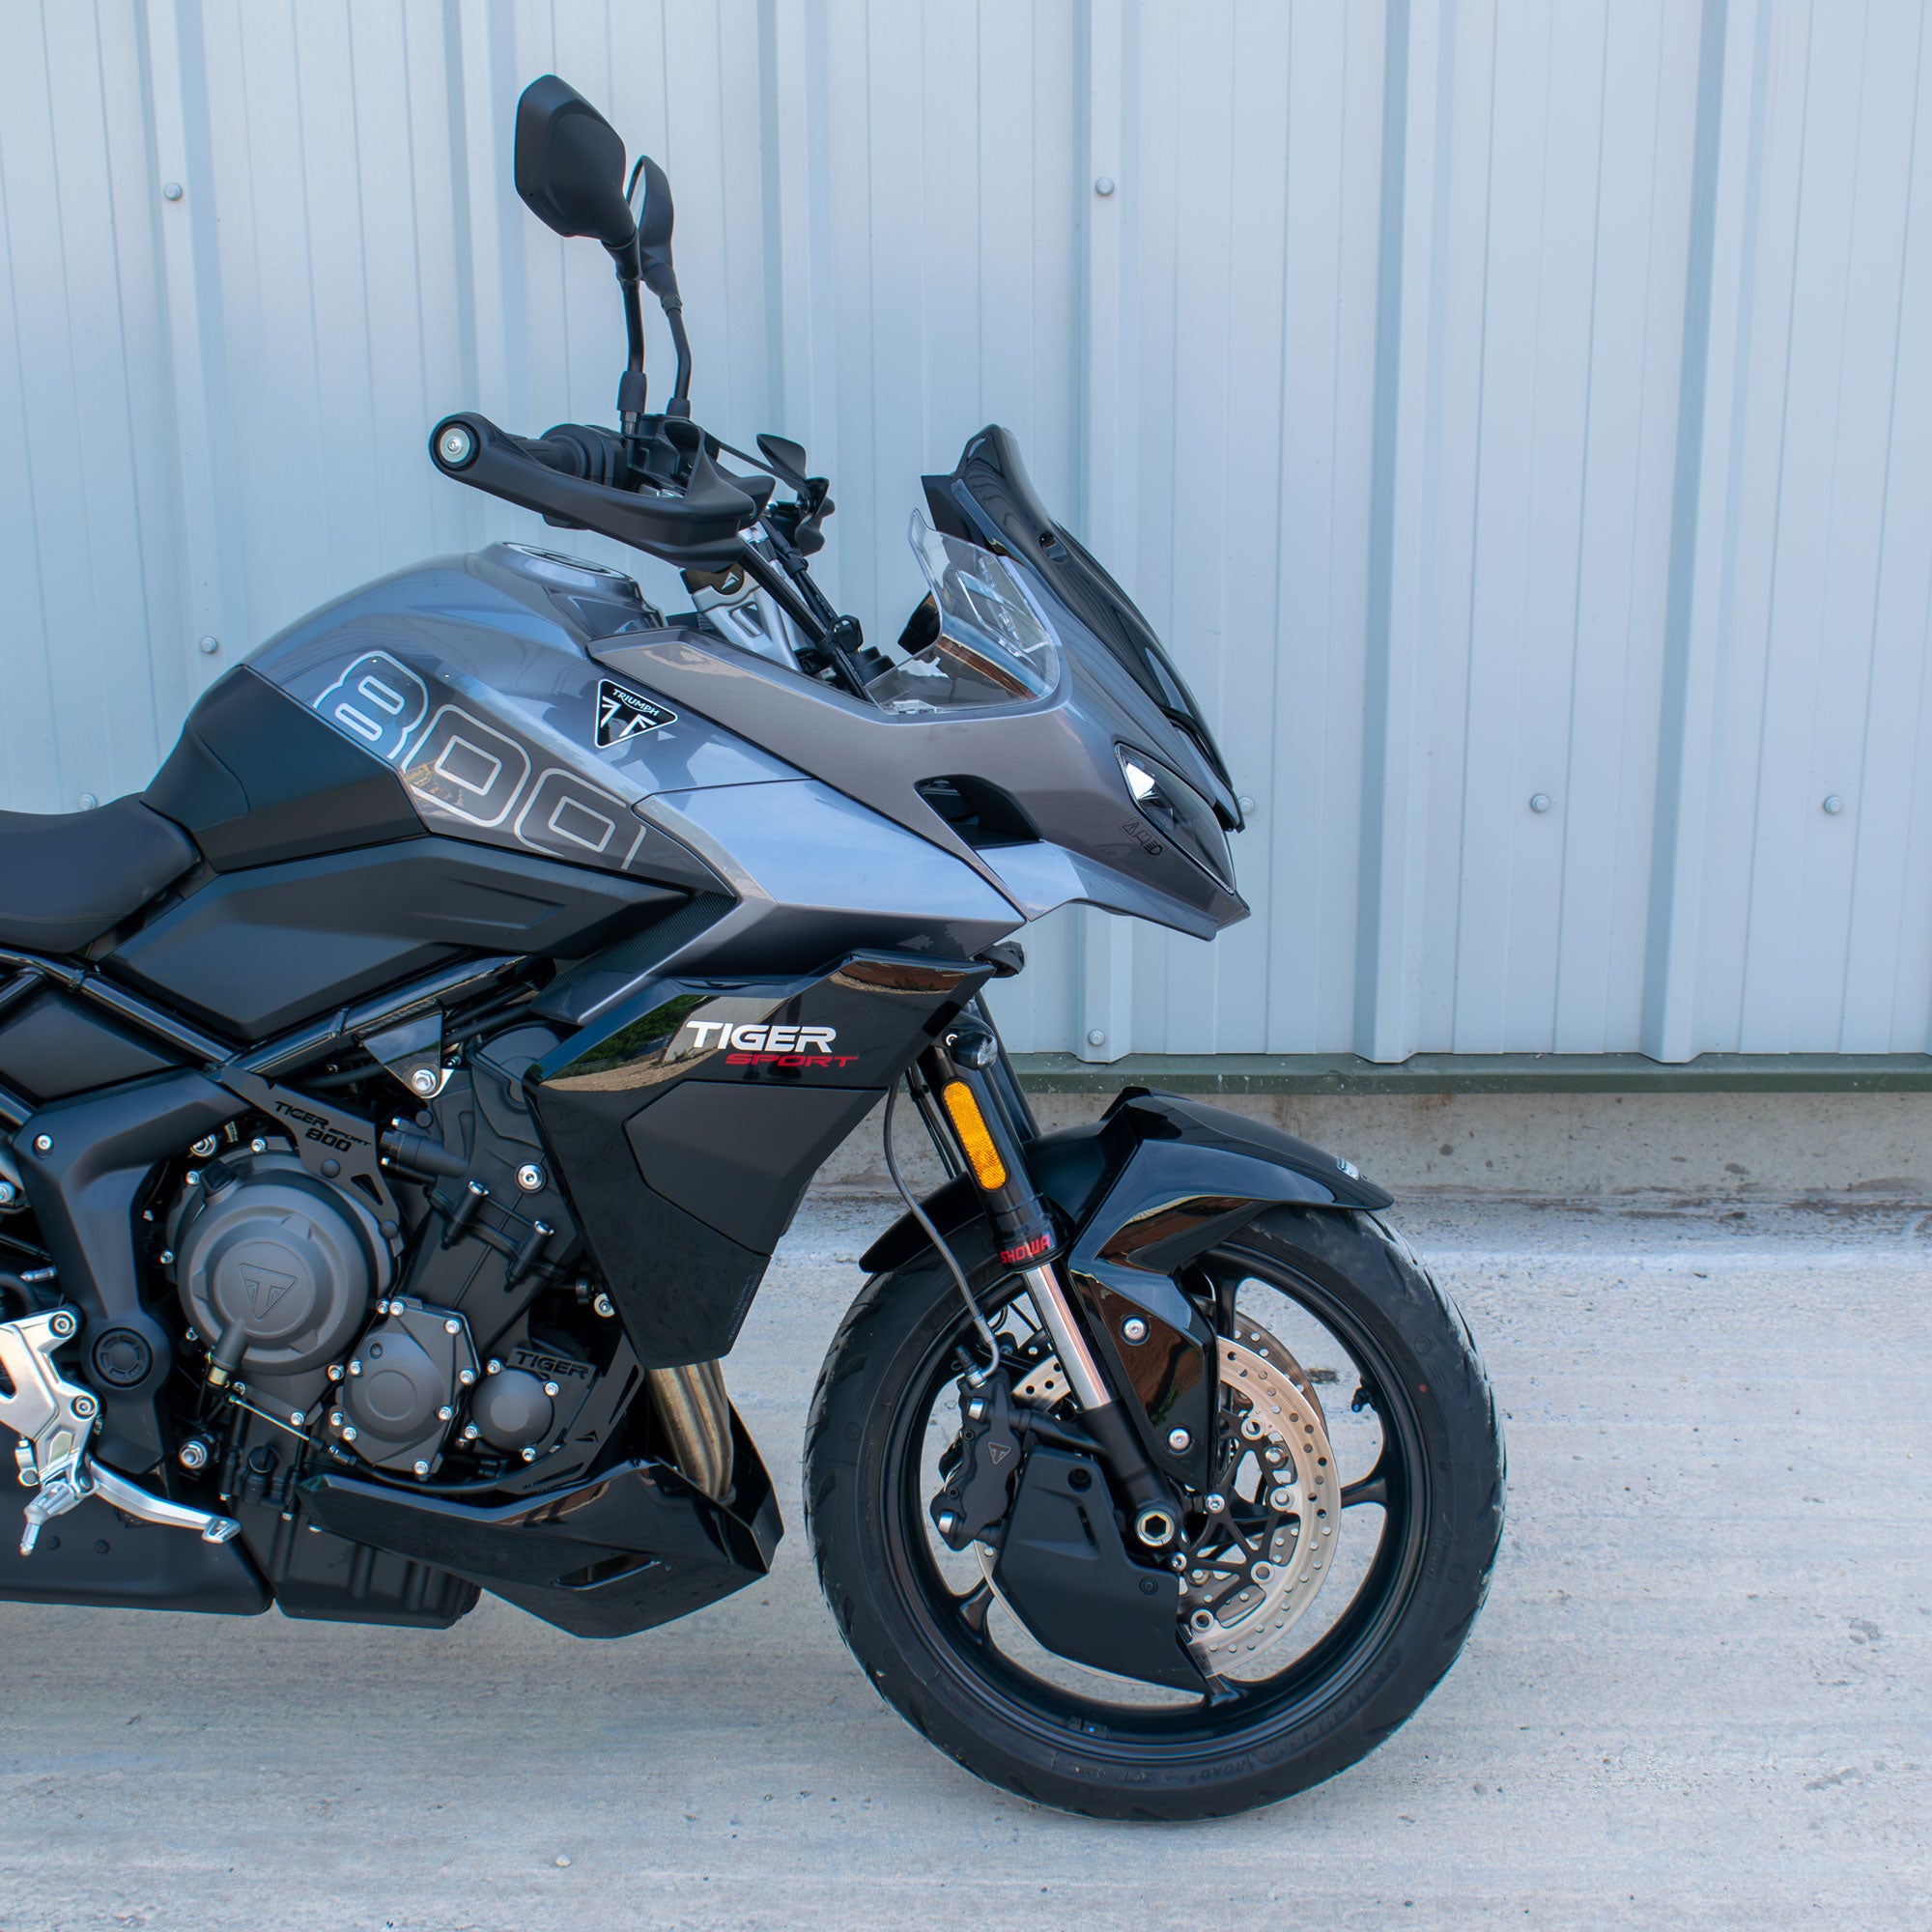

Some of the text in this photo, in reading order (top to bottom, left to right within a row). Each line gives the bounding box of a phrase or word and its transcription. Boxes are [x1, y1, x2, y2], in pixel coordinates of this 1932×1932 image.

[611, 688, 661, 717] TRIUMPH
[312, 649, 647, 870] 800
[686, 1020, 838, 1054] TIGER
[725, 1053, 859, 1067] SPORT
[274, 1100, 372, 1147] TIGER SPORT
[304, 1126, 353, 1153] 800
[999, 1233, 1051, 1264] SHOWA
[516, 1350, 589, 1380] TIGER
